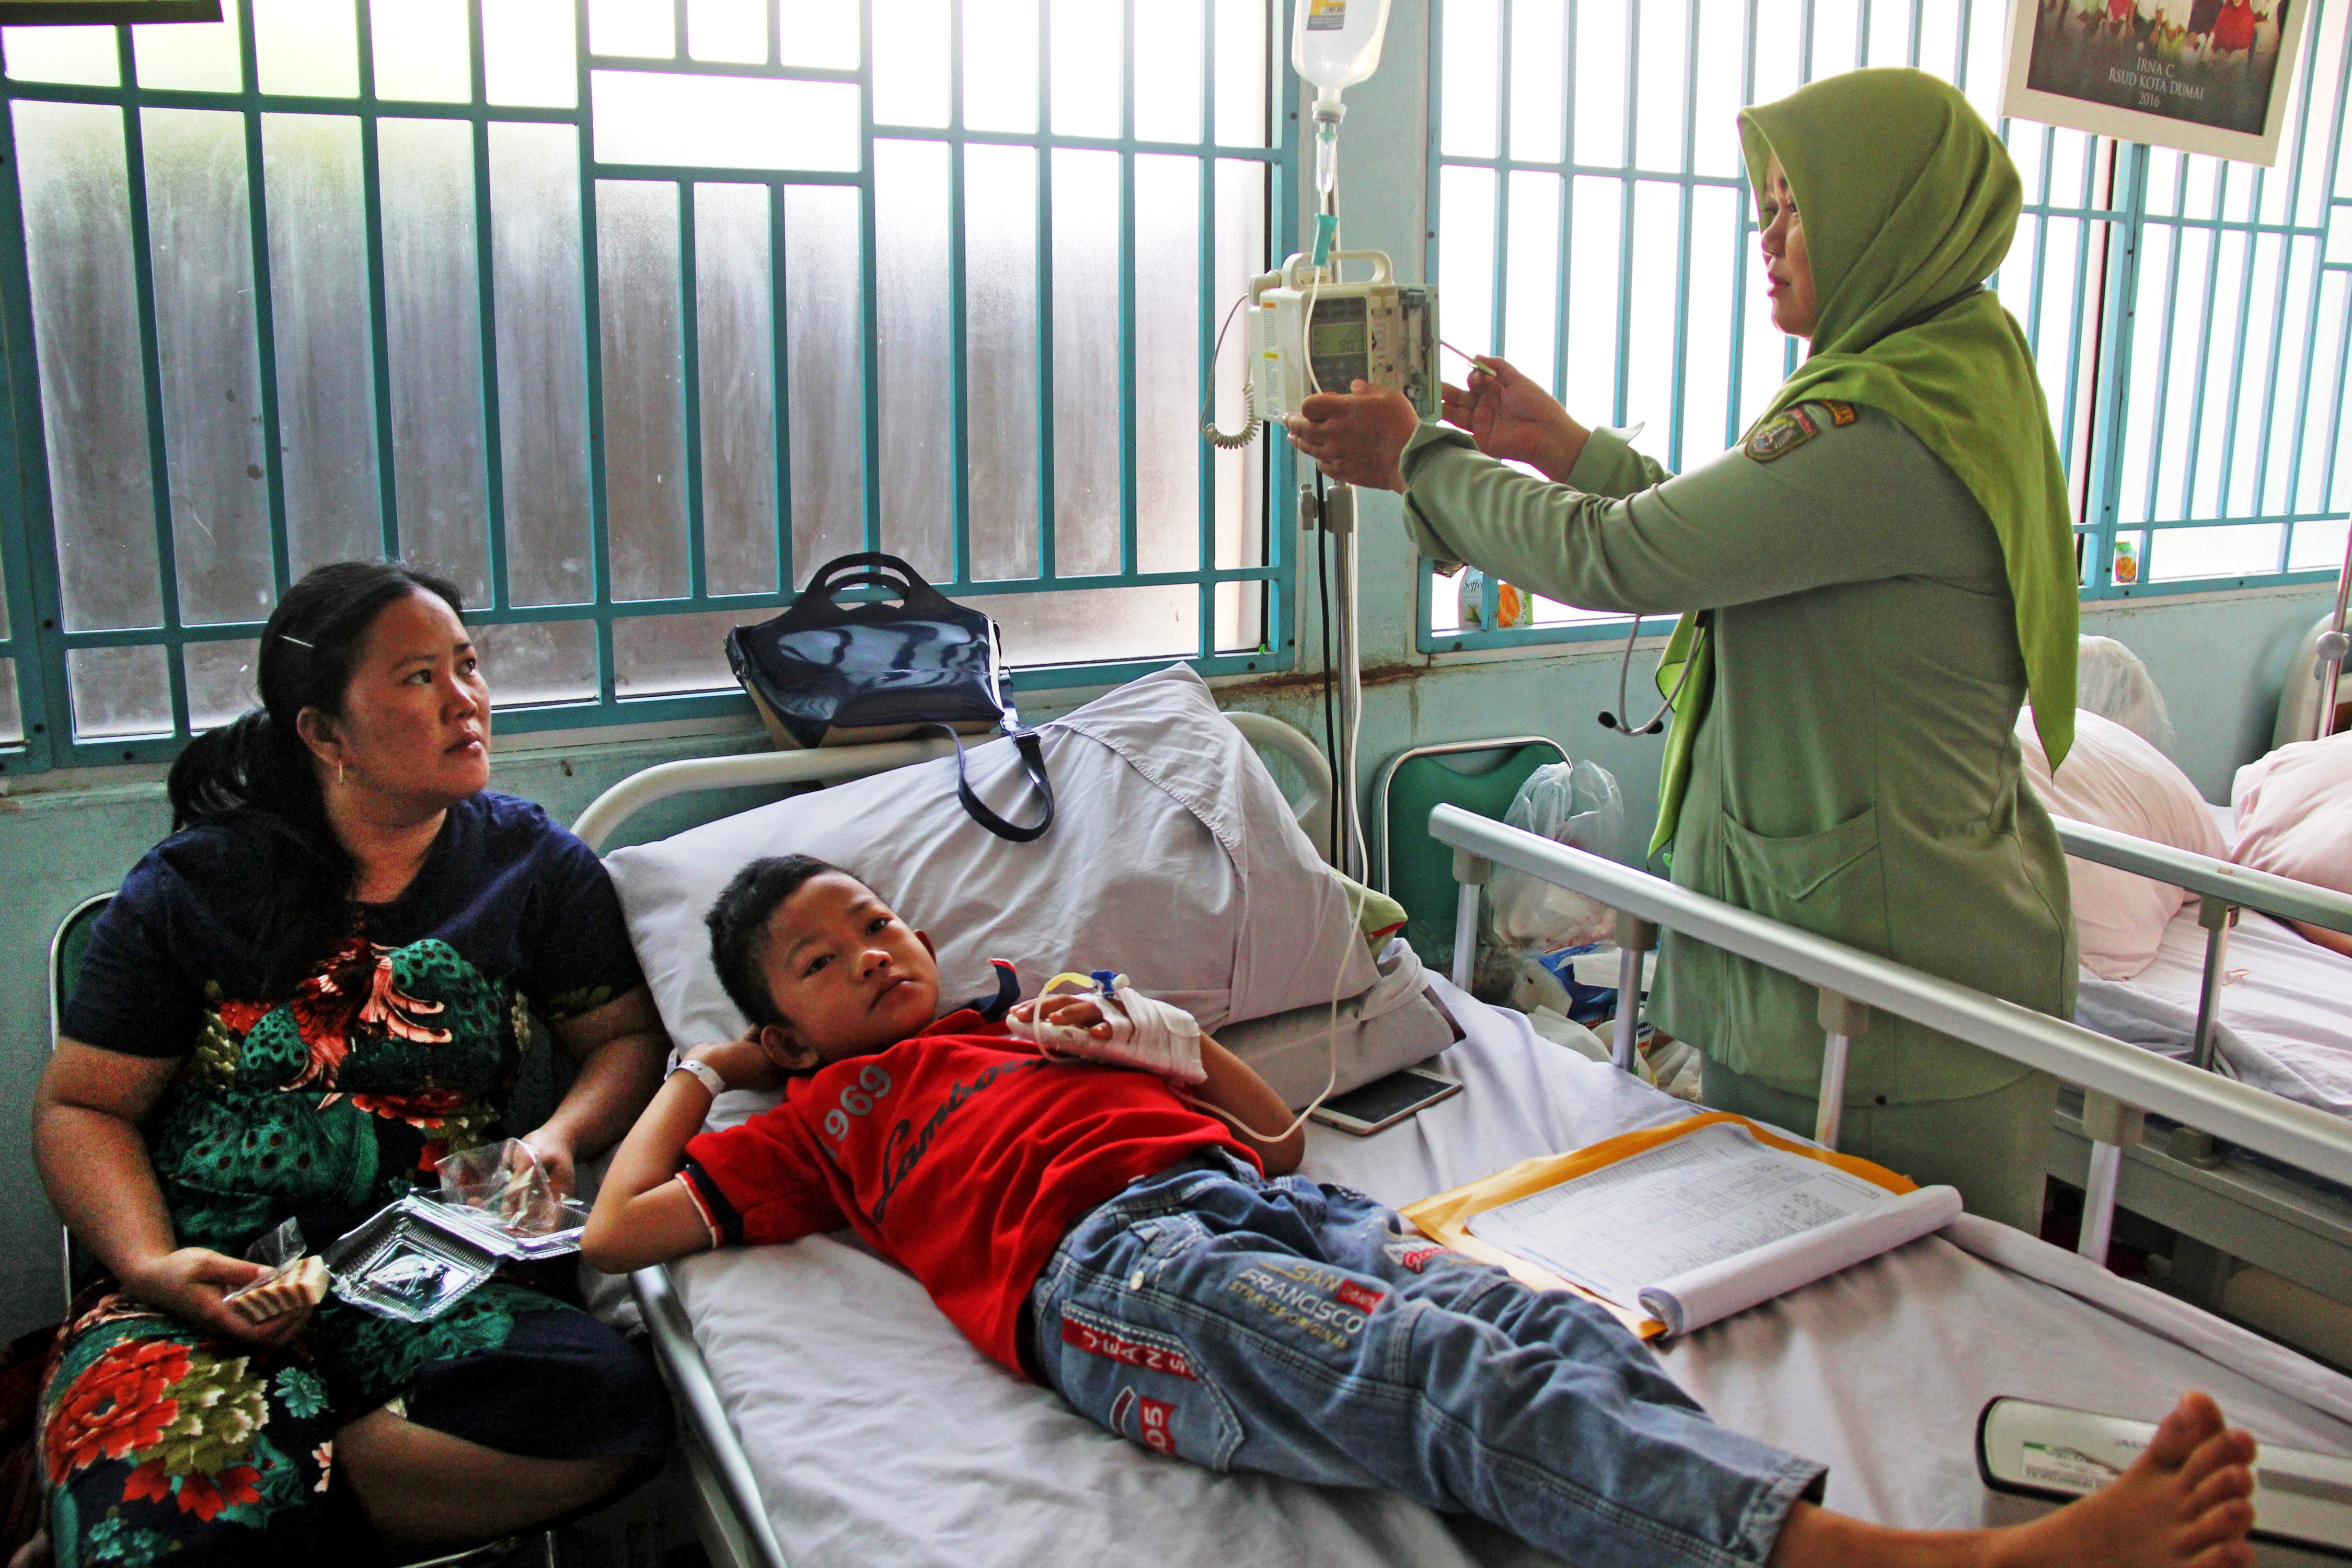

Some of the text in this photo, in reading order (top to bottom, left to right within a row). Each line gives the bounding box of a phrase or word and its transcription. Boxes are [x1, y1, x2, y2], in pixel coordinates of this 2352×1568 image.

[2137, 57, 2175, 78] IRNA C
[2109, 67, 2204, 100] RSUD KOTA DUMAI
[2138, 90, 2160, 108] 2016
[1258, 1262, 1342, 1292] SAN
[1238, 1269, 1364, 1334] FRANCISCO
[1083, 1330, 1185, 1374] JEANS
